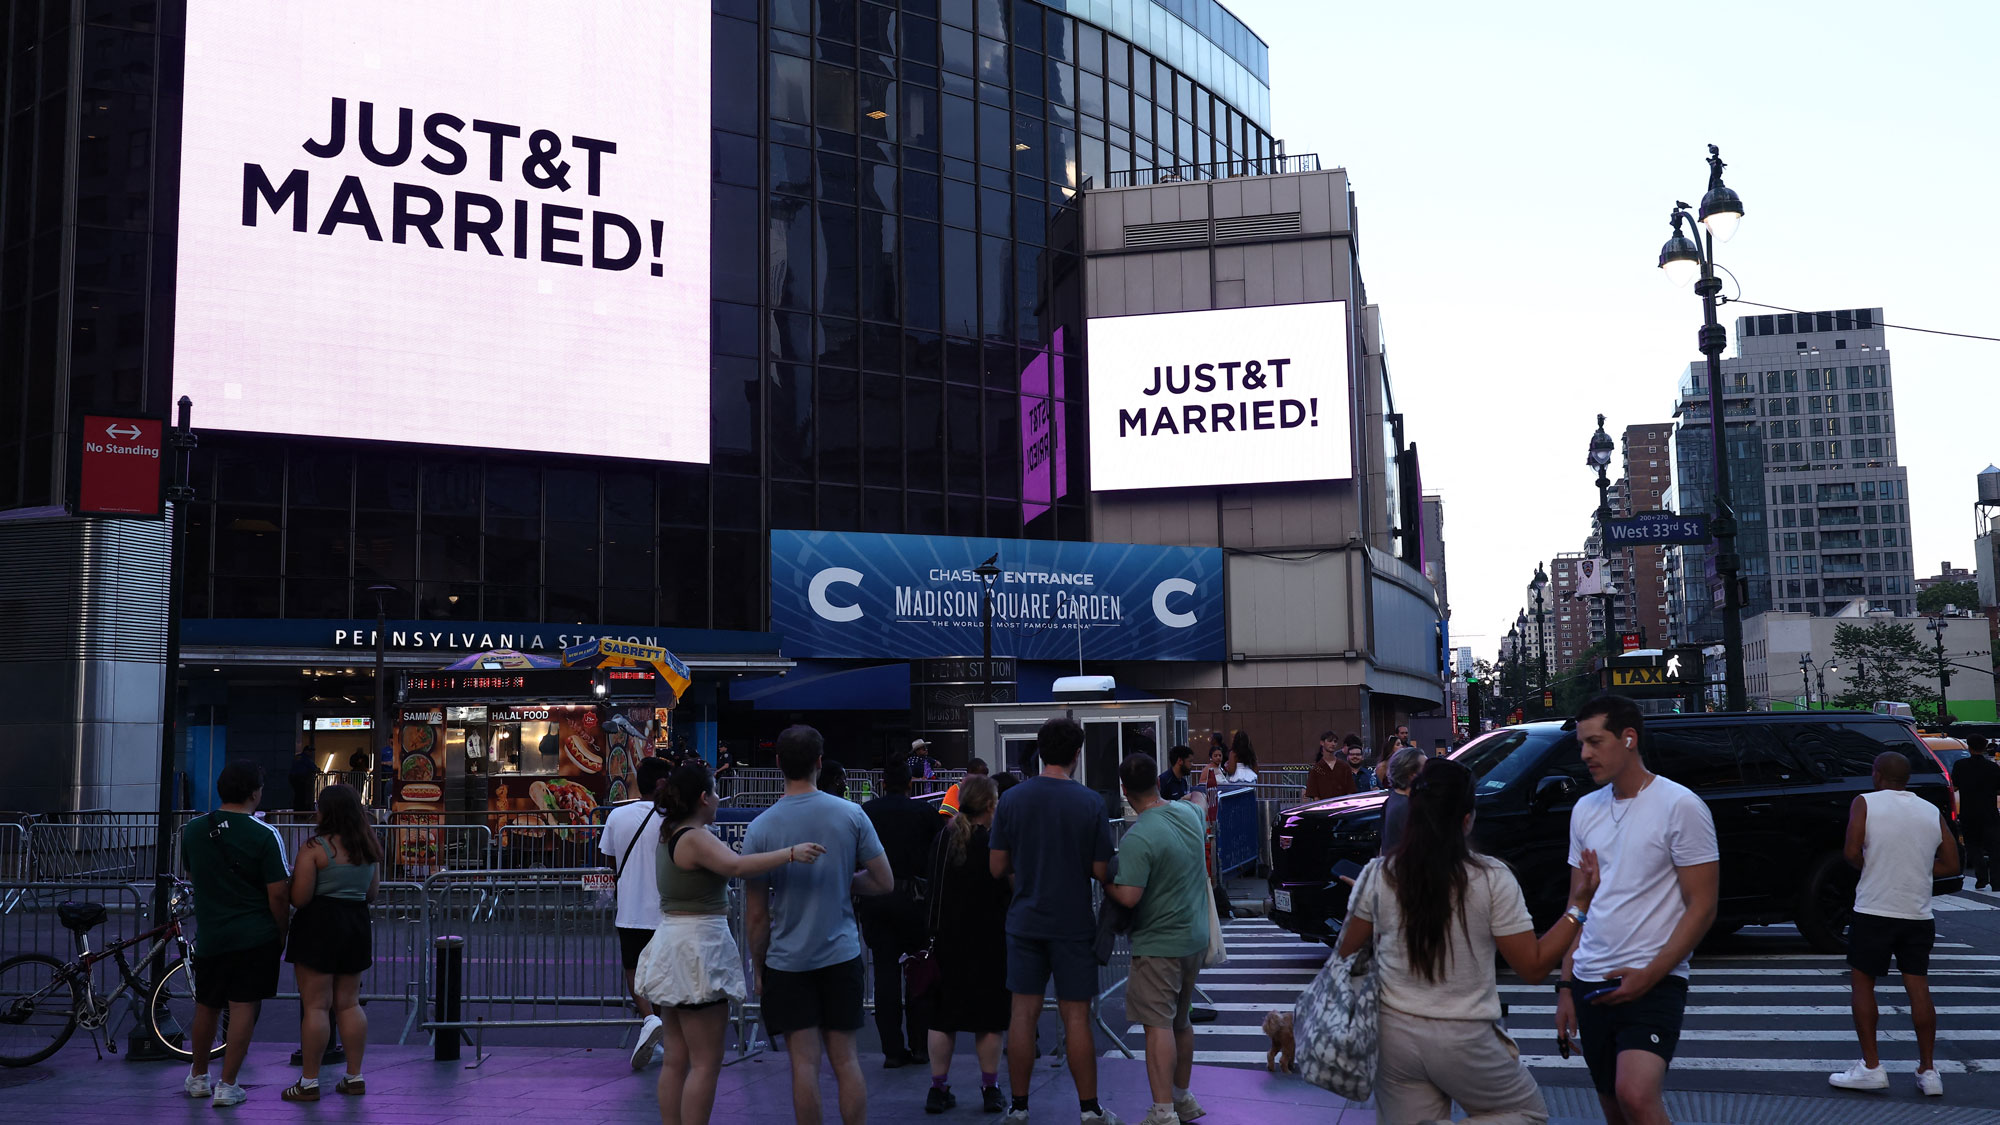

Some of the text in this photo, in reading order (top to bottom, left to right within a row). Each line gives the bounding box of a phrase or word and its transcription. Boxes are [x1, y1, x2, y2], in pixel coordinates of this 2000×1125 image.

[301, 96, 617, 197] JUST&T
[241, 162, 664, 278] MARRIED!
[1142, 358, 1291, 396] JUST&T
[1119, 397, 1318, 438] MARRIED!
[86, 442, 159, 458] No Standing
[1611, 522, 1699, 539] West 33rd St
[929, 569, 1094, 586] CHASE ENTRANCE
[895, 586, 978, 617] MADISON
[1057, 590, 1120, 620] GARDEN
[558, 634, 658, 650] STON
[603, 641, 662, 659] SABRETT
[969, 661, 1011, 678] STTION
[1616, 668, 1662, 684] TAX
[403, 711, 443, 721] SAMMY'S
[492, 710, 549, 721] HALAL FOOD
